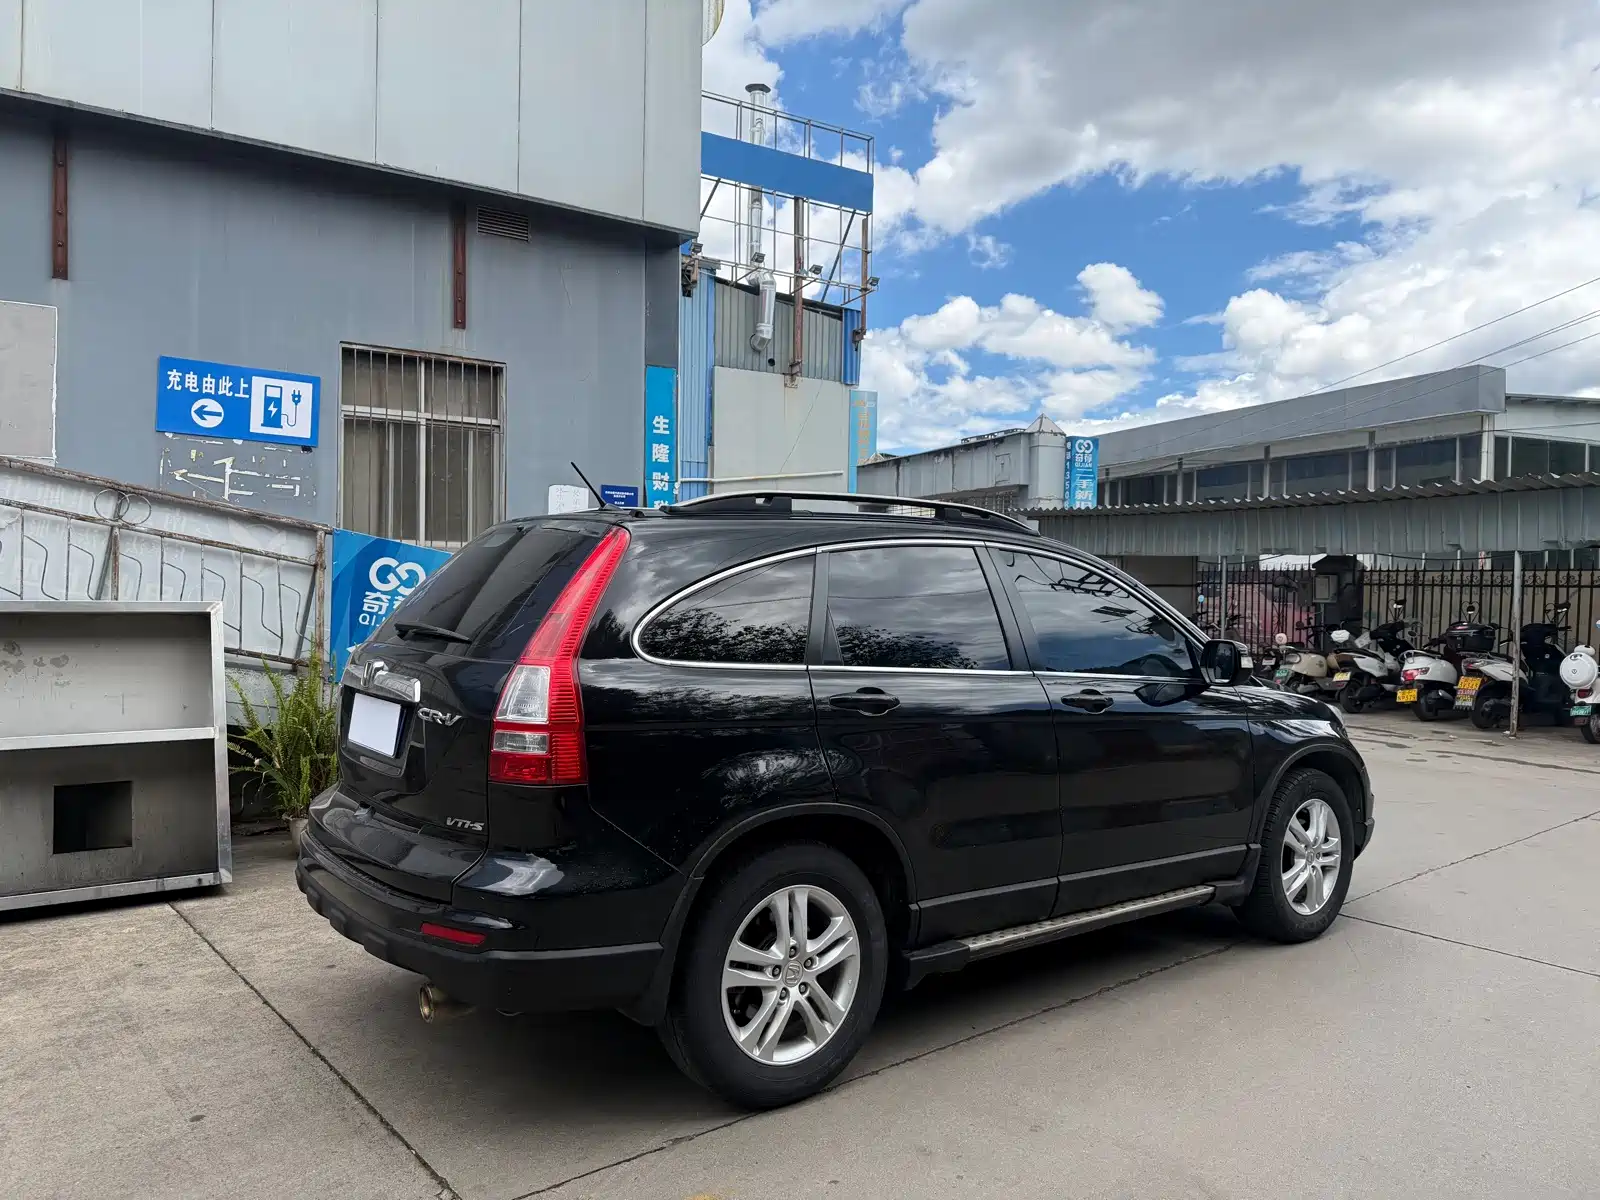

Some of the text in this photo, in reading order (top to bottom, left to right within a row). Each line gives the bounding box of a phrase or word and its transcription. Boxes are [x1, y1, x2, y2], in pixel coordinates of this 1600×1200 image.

[166, 368, 250, 399] 充电由此上
